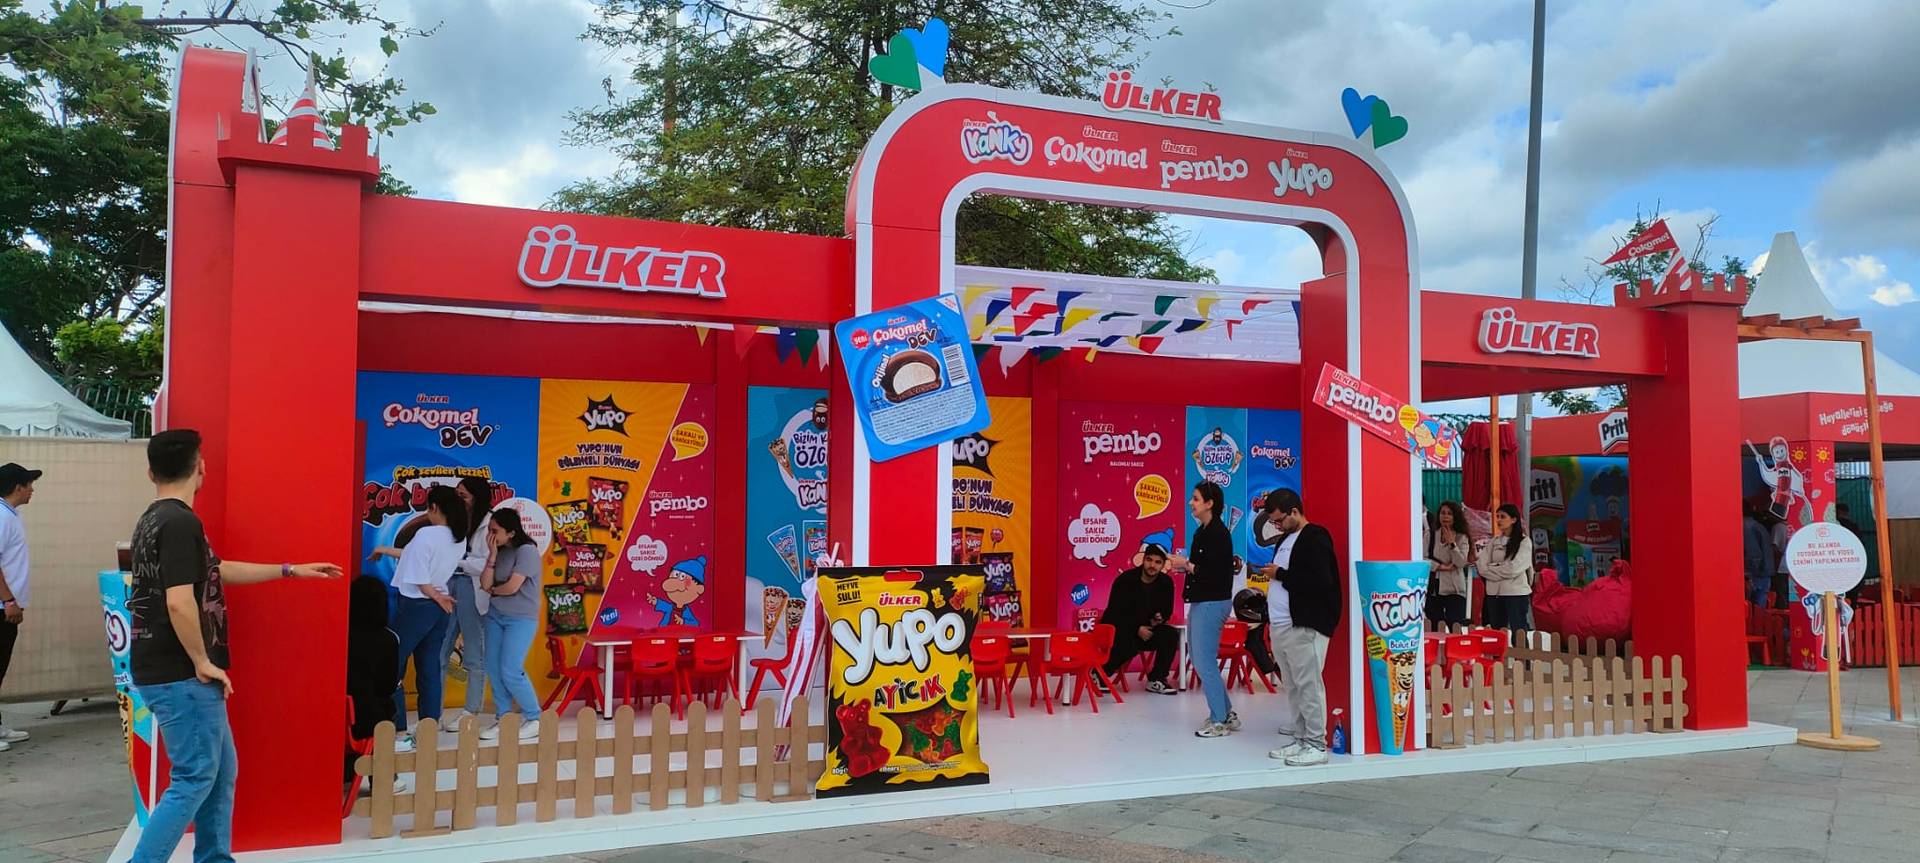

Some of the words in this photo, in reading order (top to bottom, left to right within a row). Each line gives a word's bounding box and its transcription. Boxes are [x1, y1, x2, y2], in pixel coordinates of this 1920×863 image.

[1103, 70, 1223, 124] ÜLKER
[1083, 125, 1118, 141] ÜLKER
[1044, 136, 1148, 172] Çokomel
[1161, 139, 1197, 155] ÜLKER
[1160, 155, 1249, 189] pembo
[1268, 158, 1333, 197] Yupo
[1628, 232, 1670, 257] Çokomel
[518, 224, 727, 298] ÜLKER
[872, 318, 928, 345] Çokomel
[907, 328, 938, 350] DEV
[1478, 306, 1601, 358] ÜLKER
[871, 354, 892, 388] Orijinal
[1332, 368, 1360, 391] ÜLKER
[416, 392, 449, 404] ÜLKER
[1326, 382, 1397, 424] pembo
[383, 403, 479, 430] Çokomel
[584, 409, 625, 430] Yupo
[1082, 420, 1114, 433] ÜLKER
[439, 425, 493, 449] DEV
[793, 432, 818, 444] BİZİM
[1083, 431, 1161, 463] pembo
[796, 446, 827, 466] ÖZG
[952, 437, 989, 463] upo
[1251, 445, 1290, 459] Çokomel
[952, 478, 993, 493] PO'NUN
[1530, 478, 1556, 502] ritt
[361, 483, 406, 518] Çok
[650, 495, 707, 517] pembo
[969, 496, 1014, 515] DÜNYASI
[1073, 535, 1089, 543] GERİ
[1085, 526, 1105, 534] SAKIZ
[837, 582, 859, 591] MEYVE
[837, 590, 861, 602] SULU!
[1071, 585, 1088, 601] Yeni
[1371, 592, 1399, 600] ÜLKER
[879, 592, 922, 607] ÜLKER
[600, 608, 618, 623] Yeni
[831, 608, 966, 684] Yupo
[1389, 639, 1409, 650] Bulut
